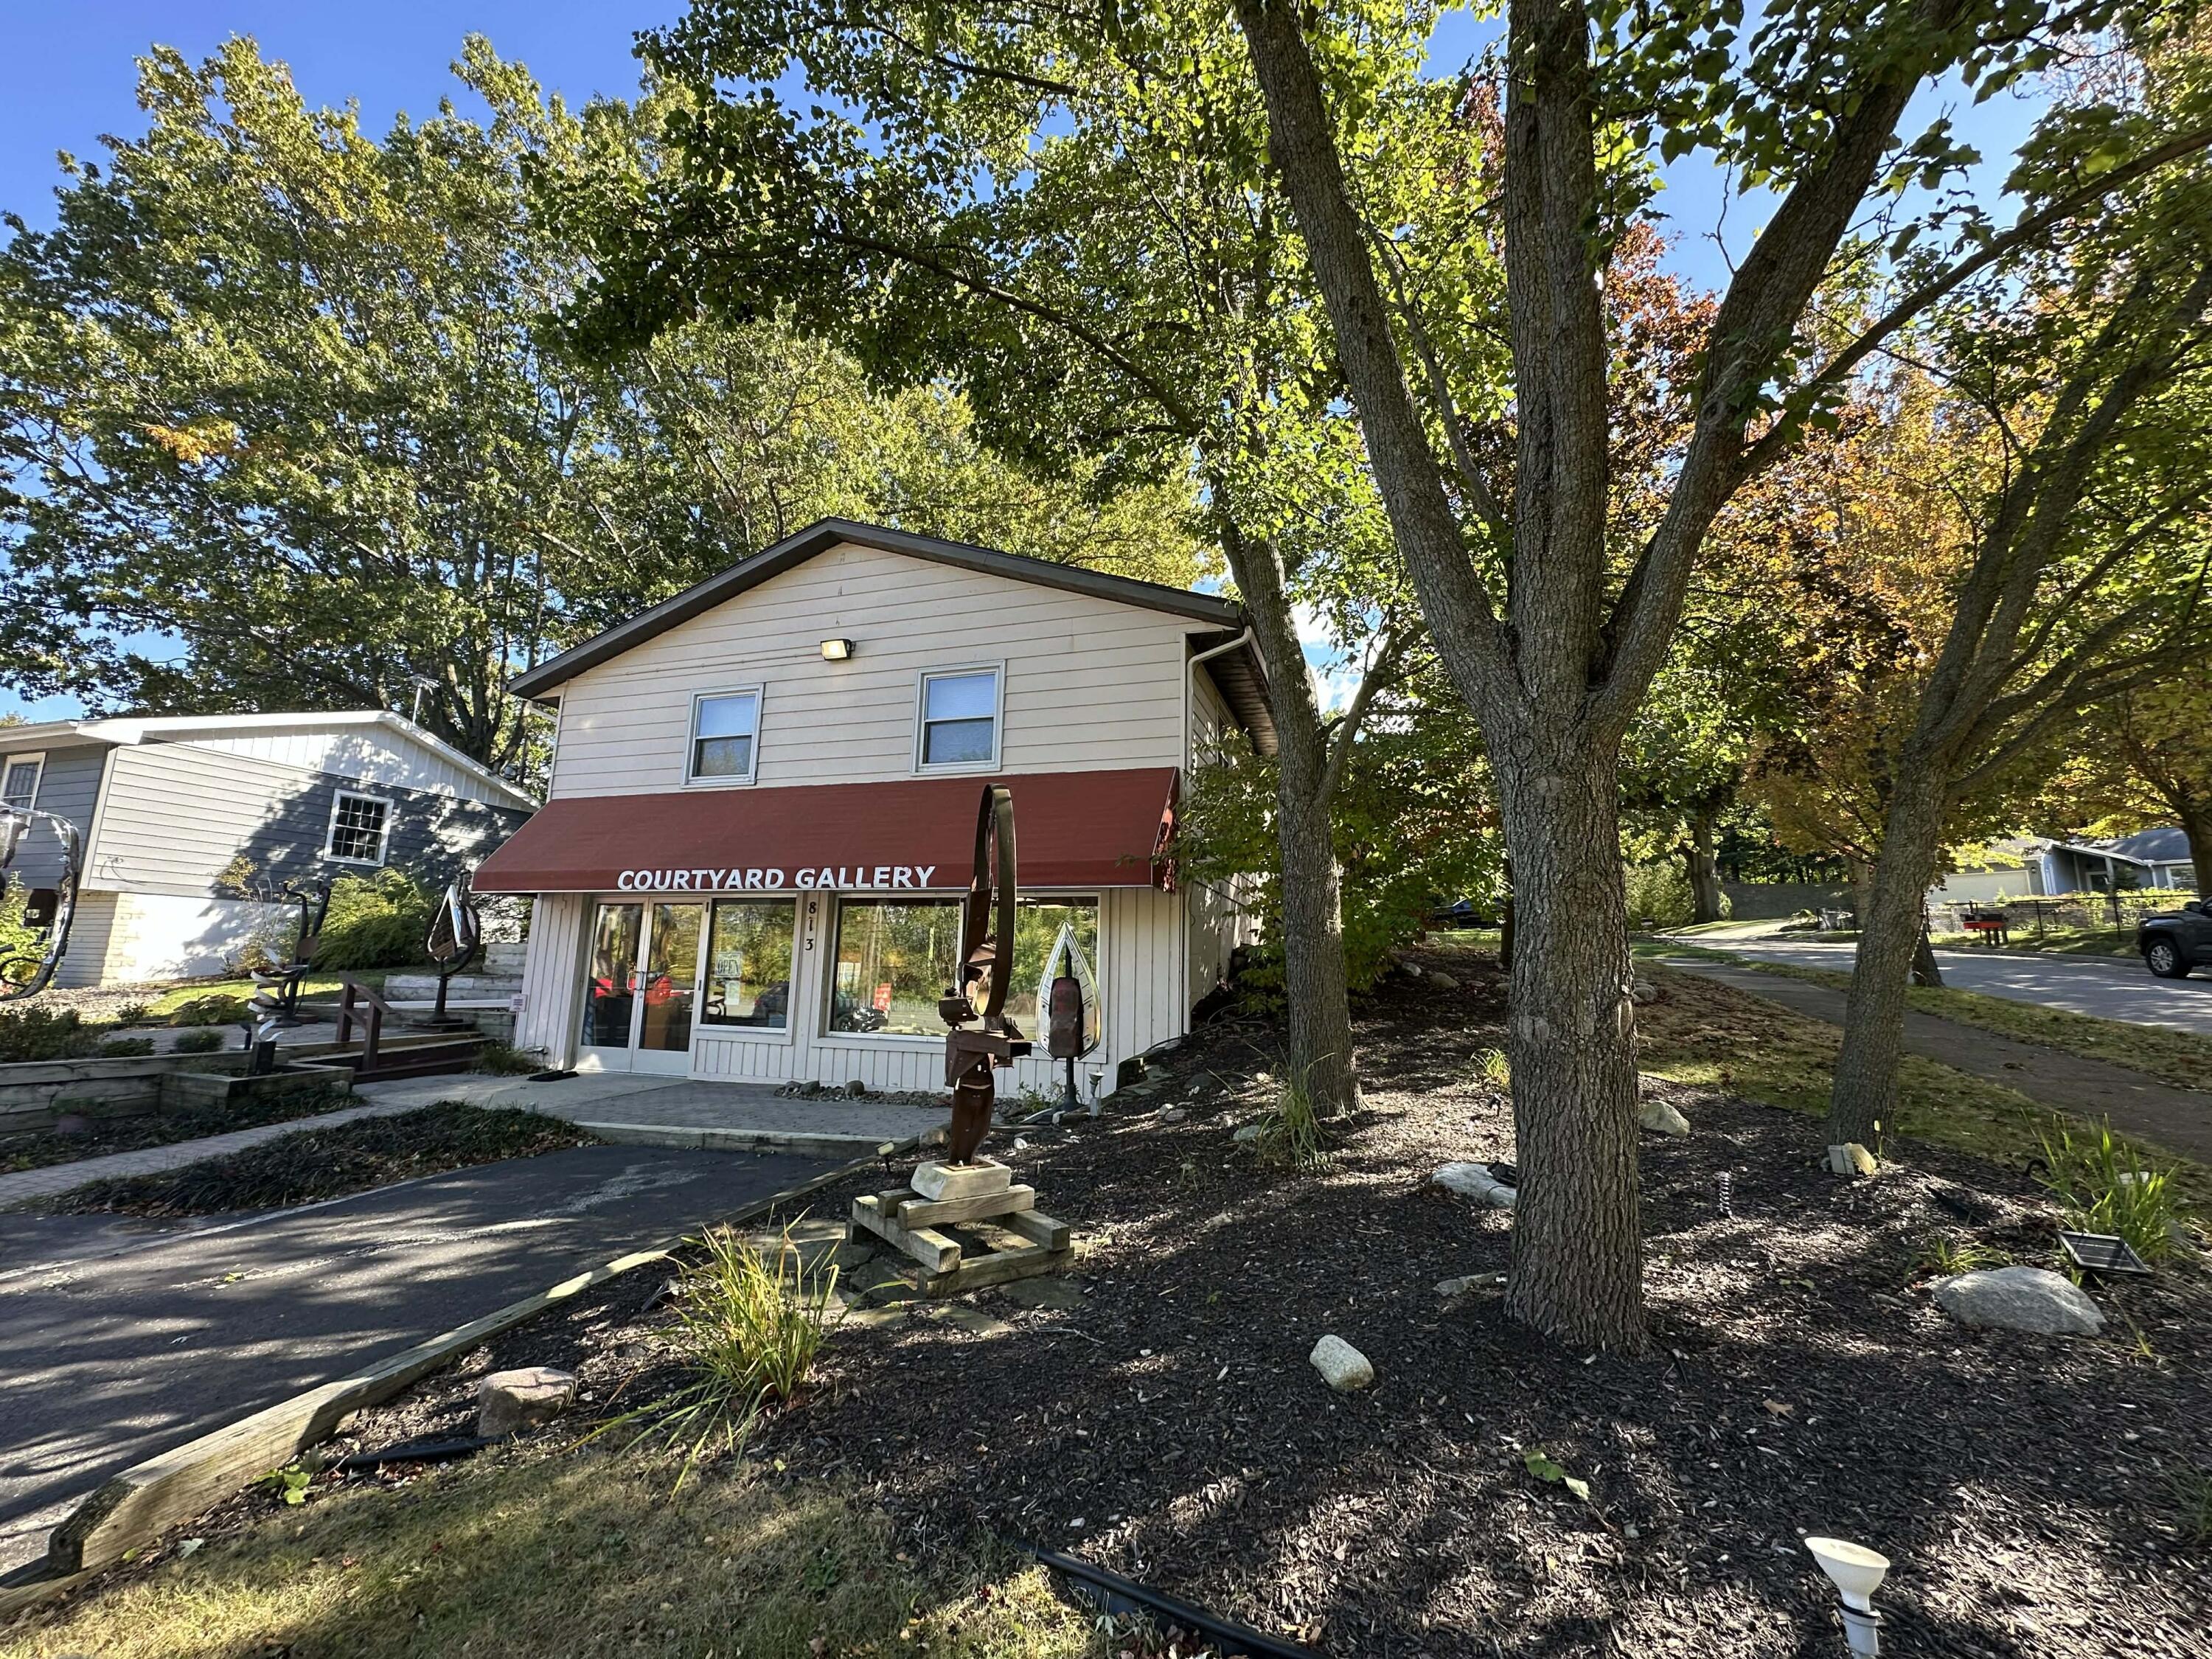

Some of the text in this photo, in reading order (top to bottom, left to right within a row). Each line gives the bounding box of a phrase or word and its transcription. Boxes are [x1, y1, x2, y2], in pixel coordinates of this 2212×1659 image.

[617, 866, 936, 889] COURTYARD GALLERY
[805, 901, 817, 951] 813
[717, 959, 740, 974] OPEN
